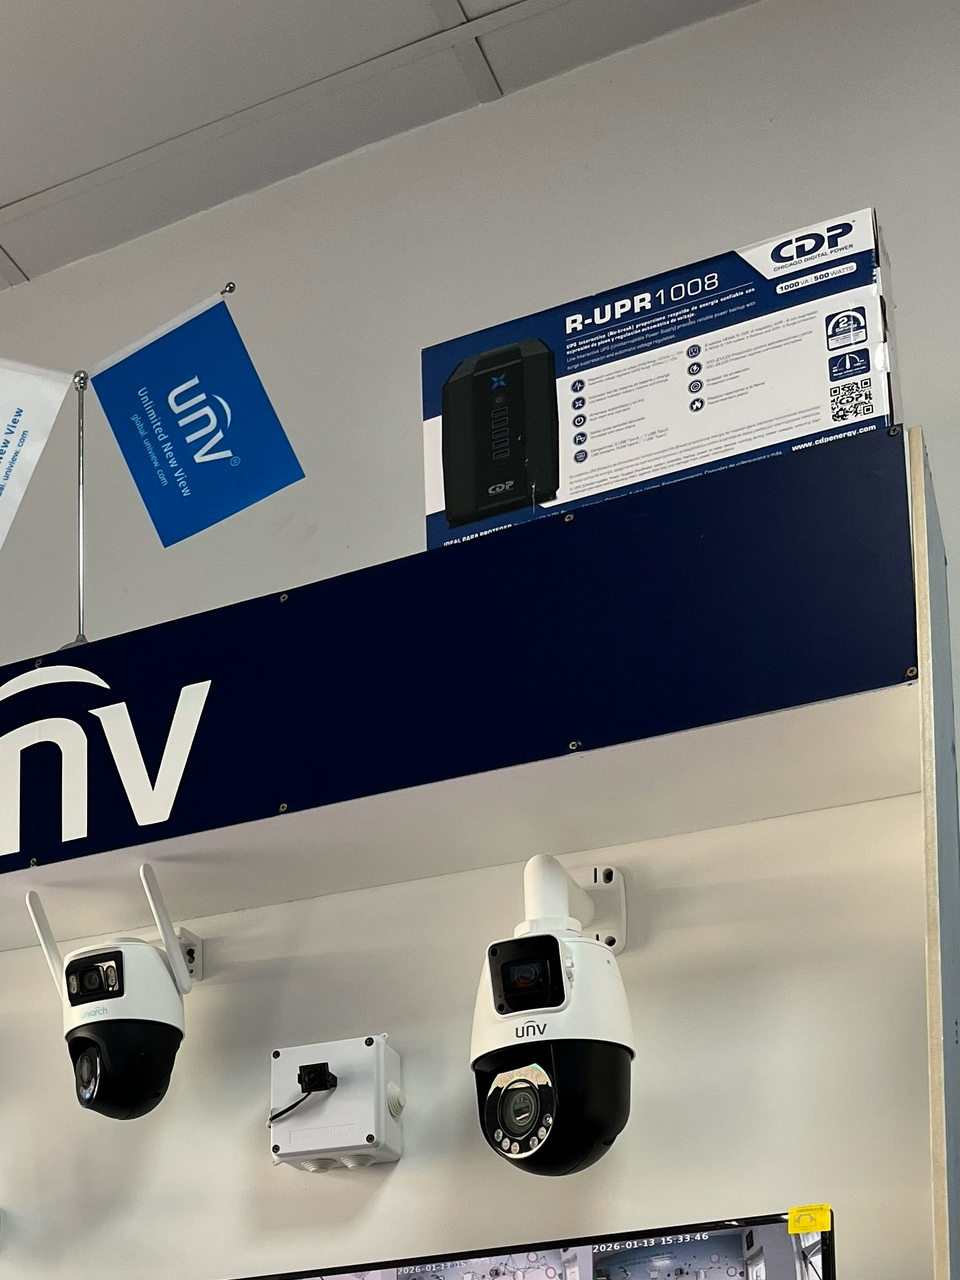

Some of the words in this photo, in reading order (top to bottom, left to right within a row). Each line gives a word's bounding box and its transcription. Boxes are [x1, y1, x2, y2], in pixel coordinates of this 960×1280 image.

[771, 223, 853, 263] CDP
[774, 260, 803, 272] CHICAGO
[803, 251, 828, 263] DIGITAL
[830, 244, 853, 254] POWER
[779, 281, 800, 292] 1000
[813, 272, 830, 281] 500
[830, 265, 854, 276] WATTS
[3, 405, 24, 437] View
[135, 385, 169, 441] Unlimited
[160, 441, 181, 469] New
[171, 467, 194, 498] View
[488, 480, 515, 496] CDP
[592, 1239, 656, 1253] 2026-01-13
[660, 1232, 710, 1245] 15:33:46
